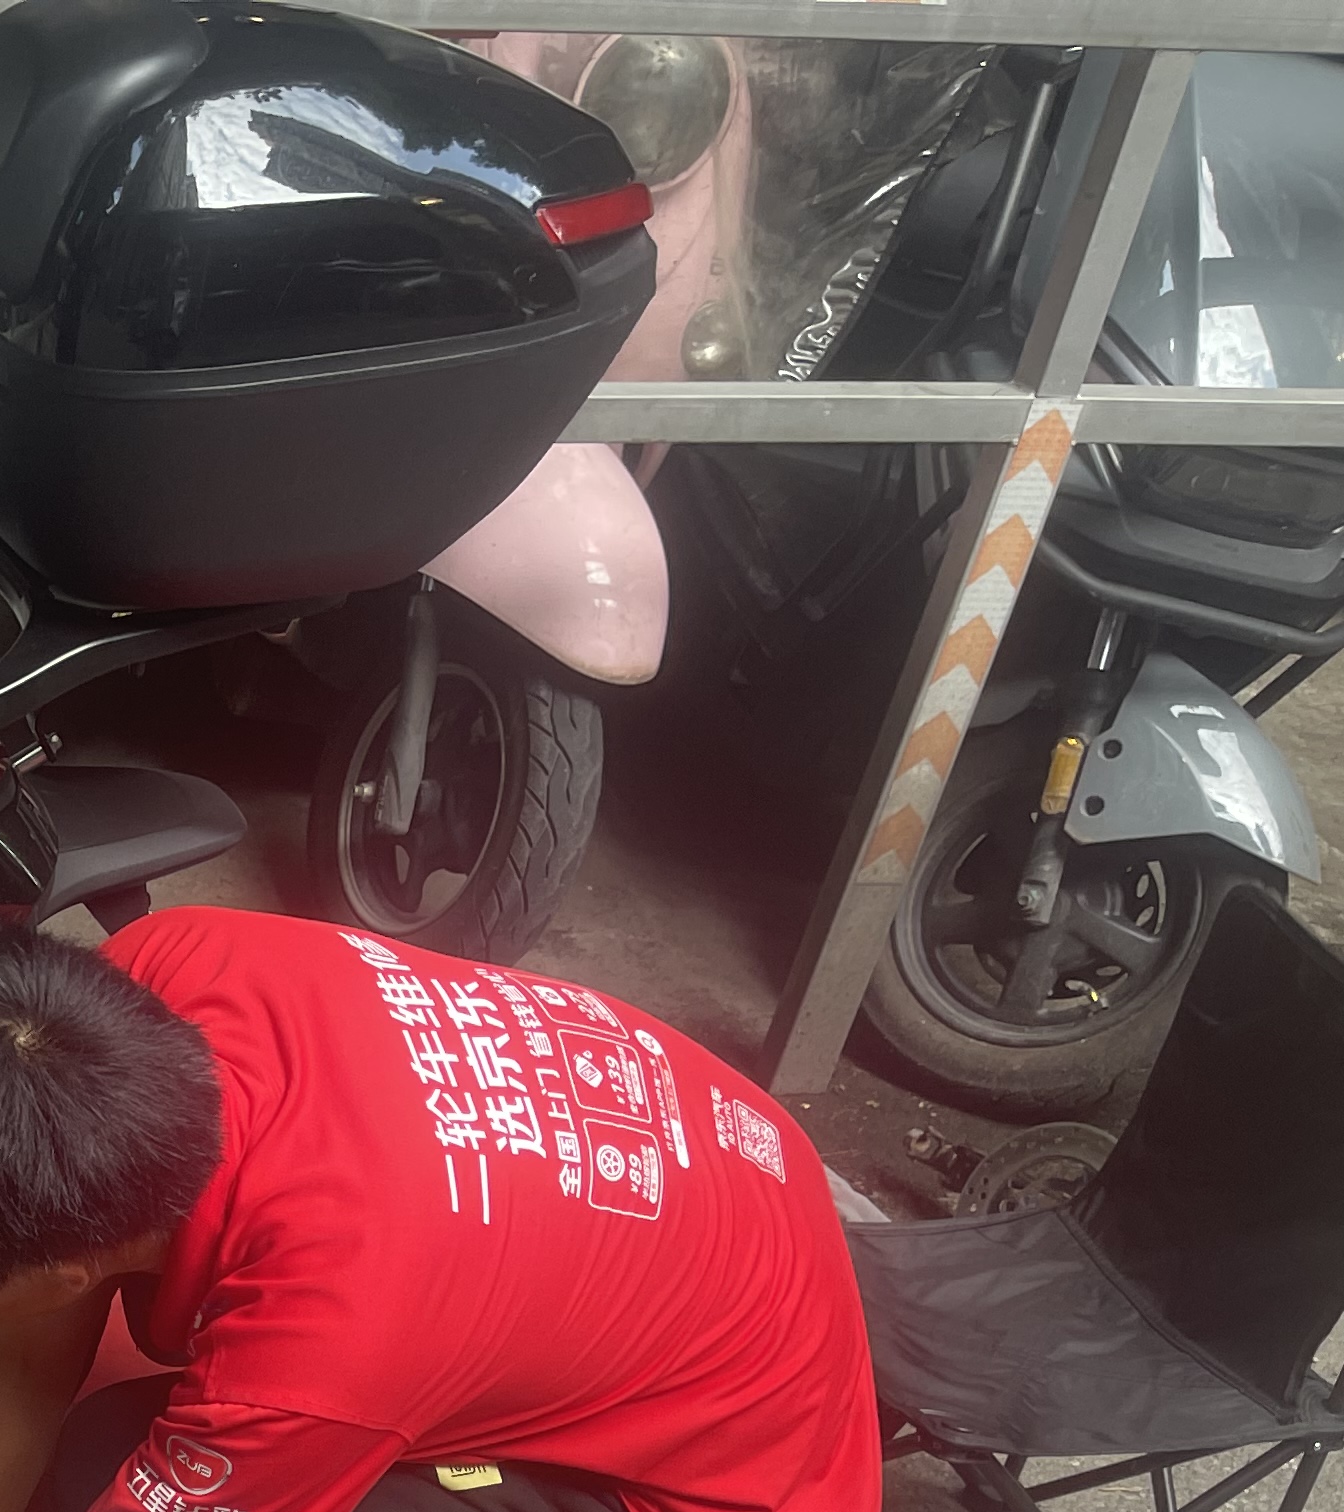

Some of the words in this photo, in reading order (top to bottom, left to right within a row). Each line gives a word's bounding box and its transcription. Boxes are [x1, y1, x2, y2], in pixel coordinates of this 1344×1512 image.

[336, 930, 491, 1226] 二轮车维修
[444, 979, 548, 1160] 选京东
[541, 1066, 584, 1199] 全国上门
[606, 1054, 626, 1106] ¥139
[628, 1153, 643, 1194] ¥89
